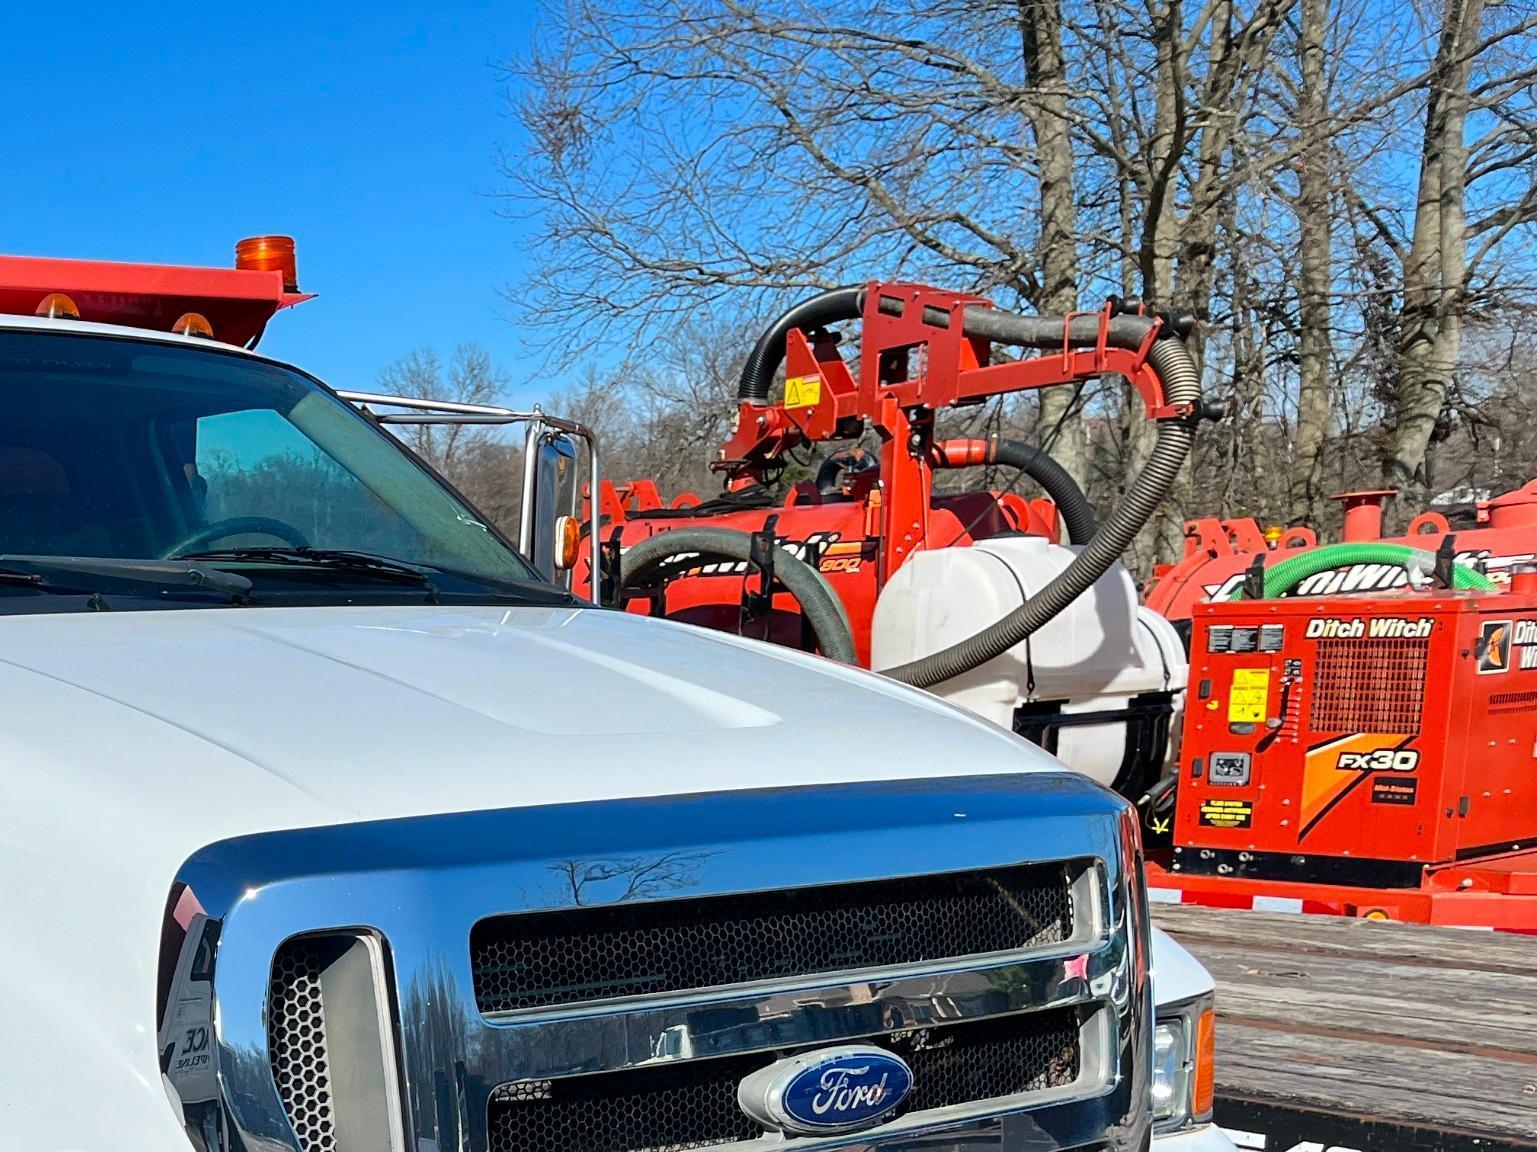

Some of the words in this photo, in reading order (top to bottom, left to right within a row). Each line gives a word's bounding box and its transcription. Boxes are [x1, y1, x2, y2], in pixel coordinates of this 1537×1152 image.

[1305, 618, 1365, 638] Ditch
[1369, 618, 1432, 638] Witch
[1337, 749, 1418, 771] FX30
[812, 1065, 889, 1115] Ford
